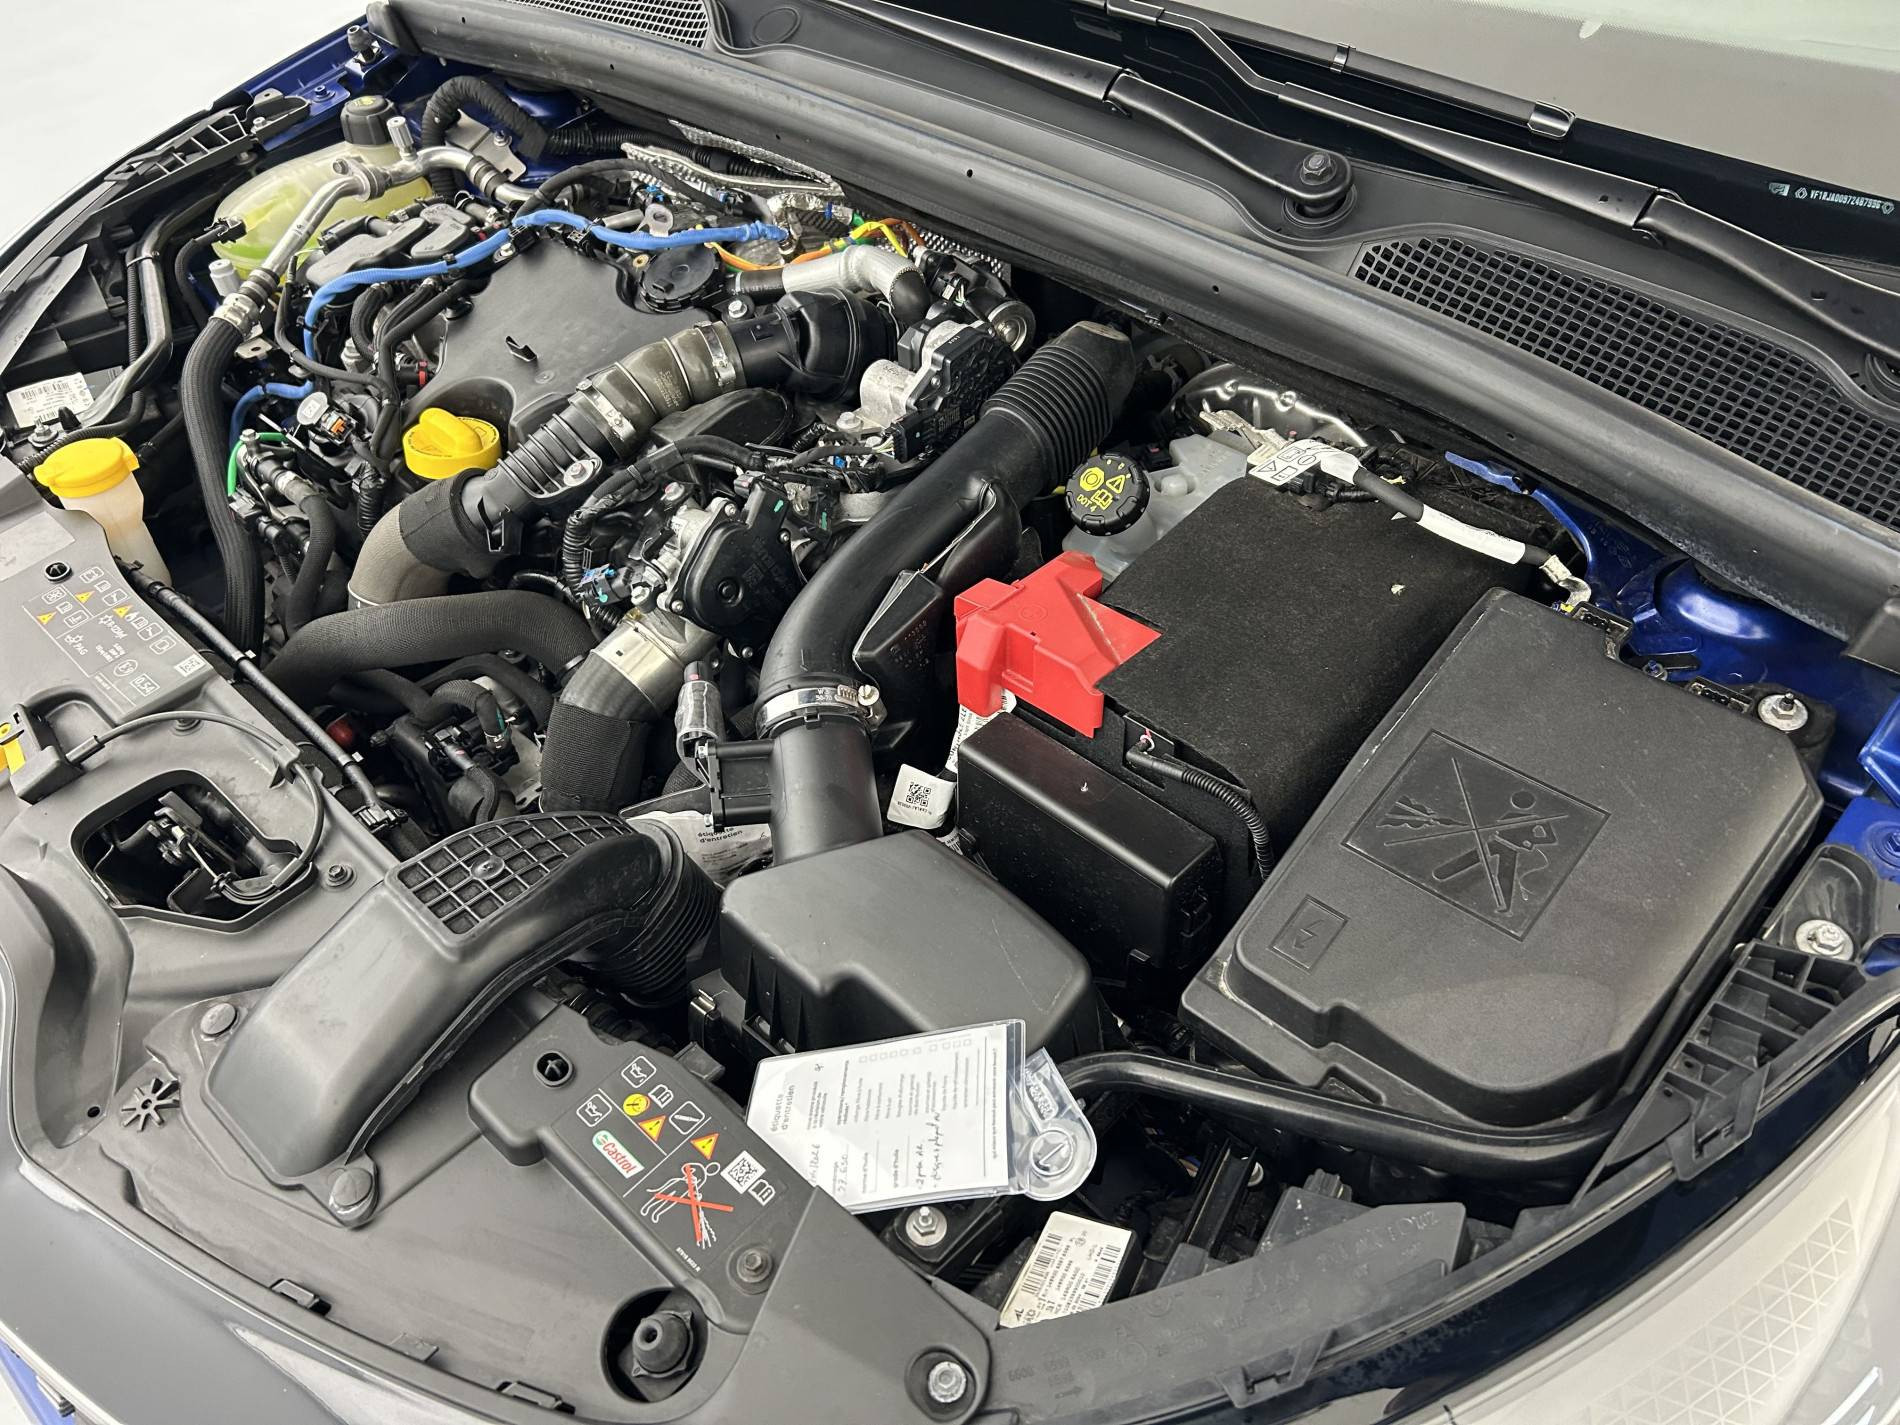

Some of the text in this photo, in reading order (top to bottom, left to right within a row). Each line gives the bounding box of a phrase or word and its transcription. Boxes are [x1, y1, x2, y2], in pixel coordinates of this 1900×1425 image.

[1077, 494, 1092, 508] DOT
[73, 643, 88, 655] PAG
[698, 828, 734, 838] étiqute
[700, 830, 743, 843] d'entretien
[770, 1093, 784, 1132] étiquette
[781, 1084, 795, 1130] d'entretien
[602, 1142, 637, 1173] Castrol
